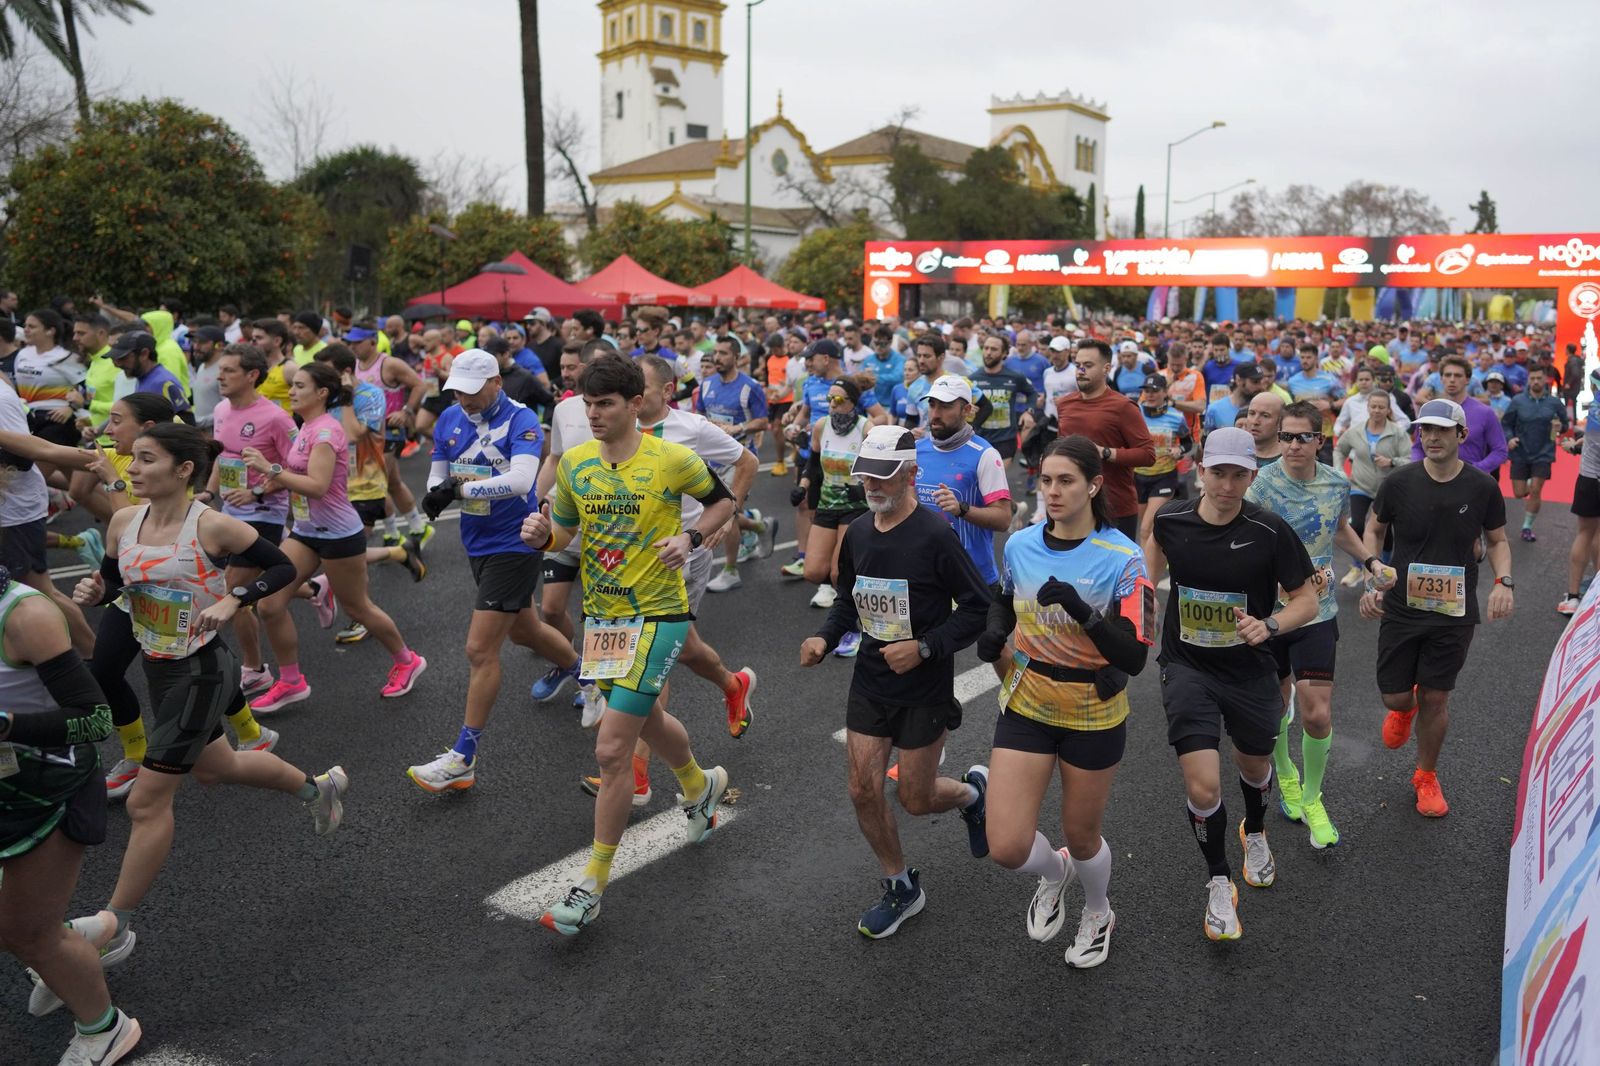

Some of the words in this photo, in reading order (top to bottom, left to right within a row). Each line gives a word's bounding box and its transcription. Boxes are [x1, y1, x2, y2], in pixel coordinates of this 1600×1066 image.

[604, 493, 645, 501] TRIATLÓN
[585, 501, 640, 515] CAMALEÓN
[1417, 576, 1451, 594] 7331
[139, 595, 170, 625] 9401
[855, 592, 897, 614] 21961
[1184, 602, 1235, 623] 10010
[593, 631, 627, 651] 7878
[1548, 708, 1594, 871] CREATE
